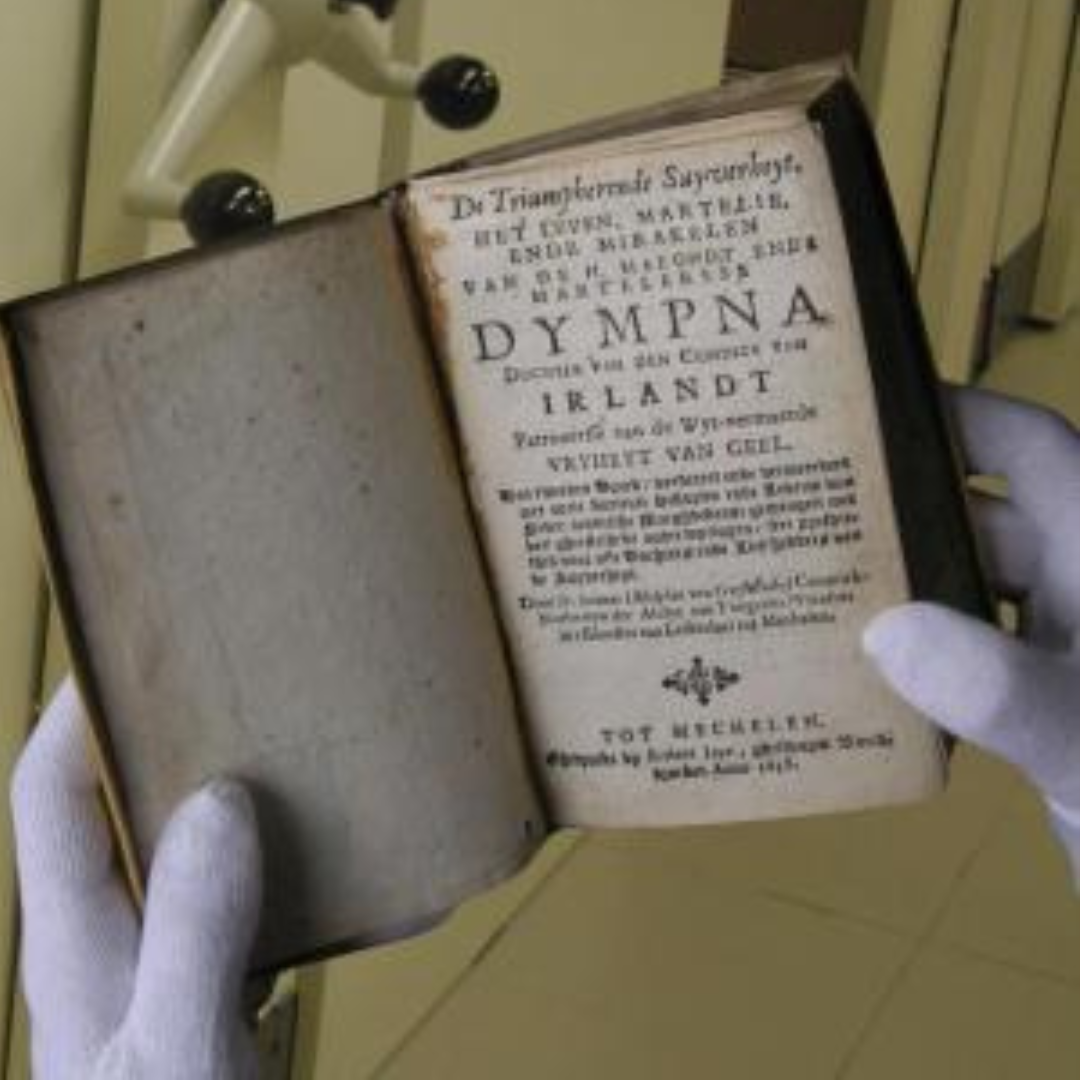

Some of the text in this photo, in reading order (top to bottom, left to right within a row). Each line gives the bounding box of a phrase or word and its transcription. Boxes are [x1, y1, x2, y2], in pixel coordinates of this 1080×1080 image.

[471, 285, 830, 361] DYMPNA
[543, 370, 770, 414] IRLANDT
[665, 442, 714, 462] VAN
